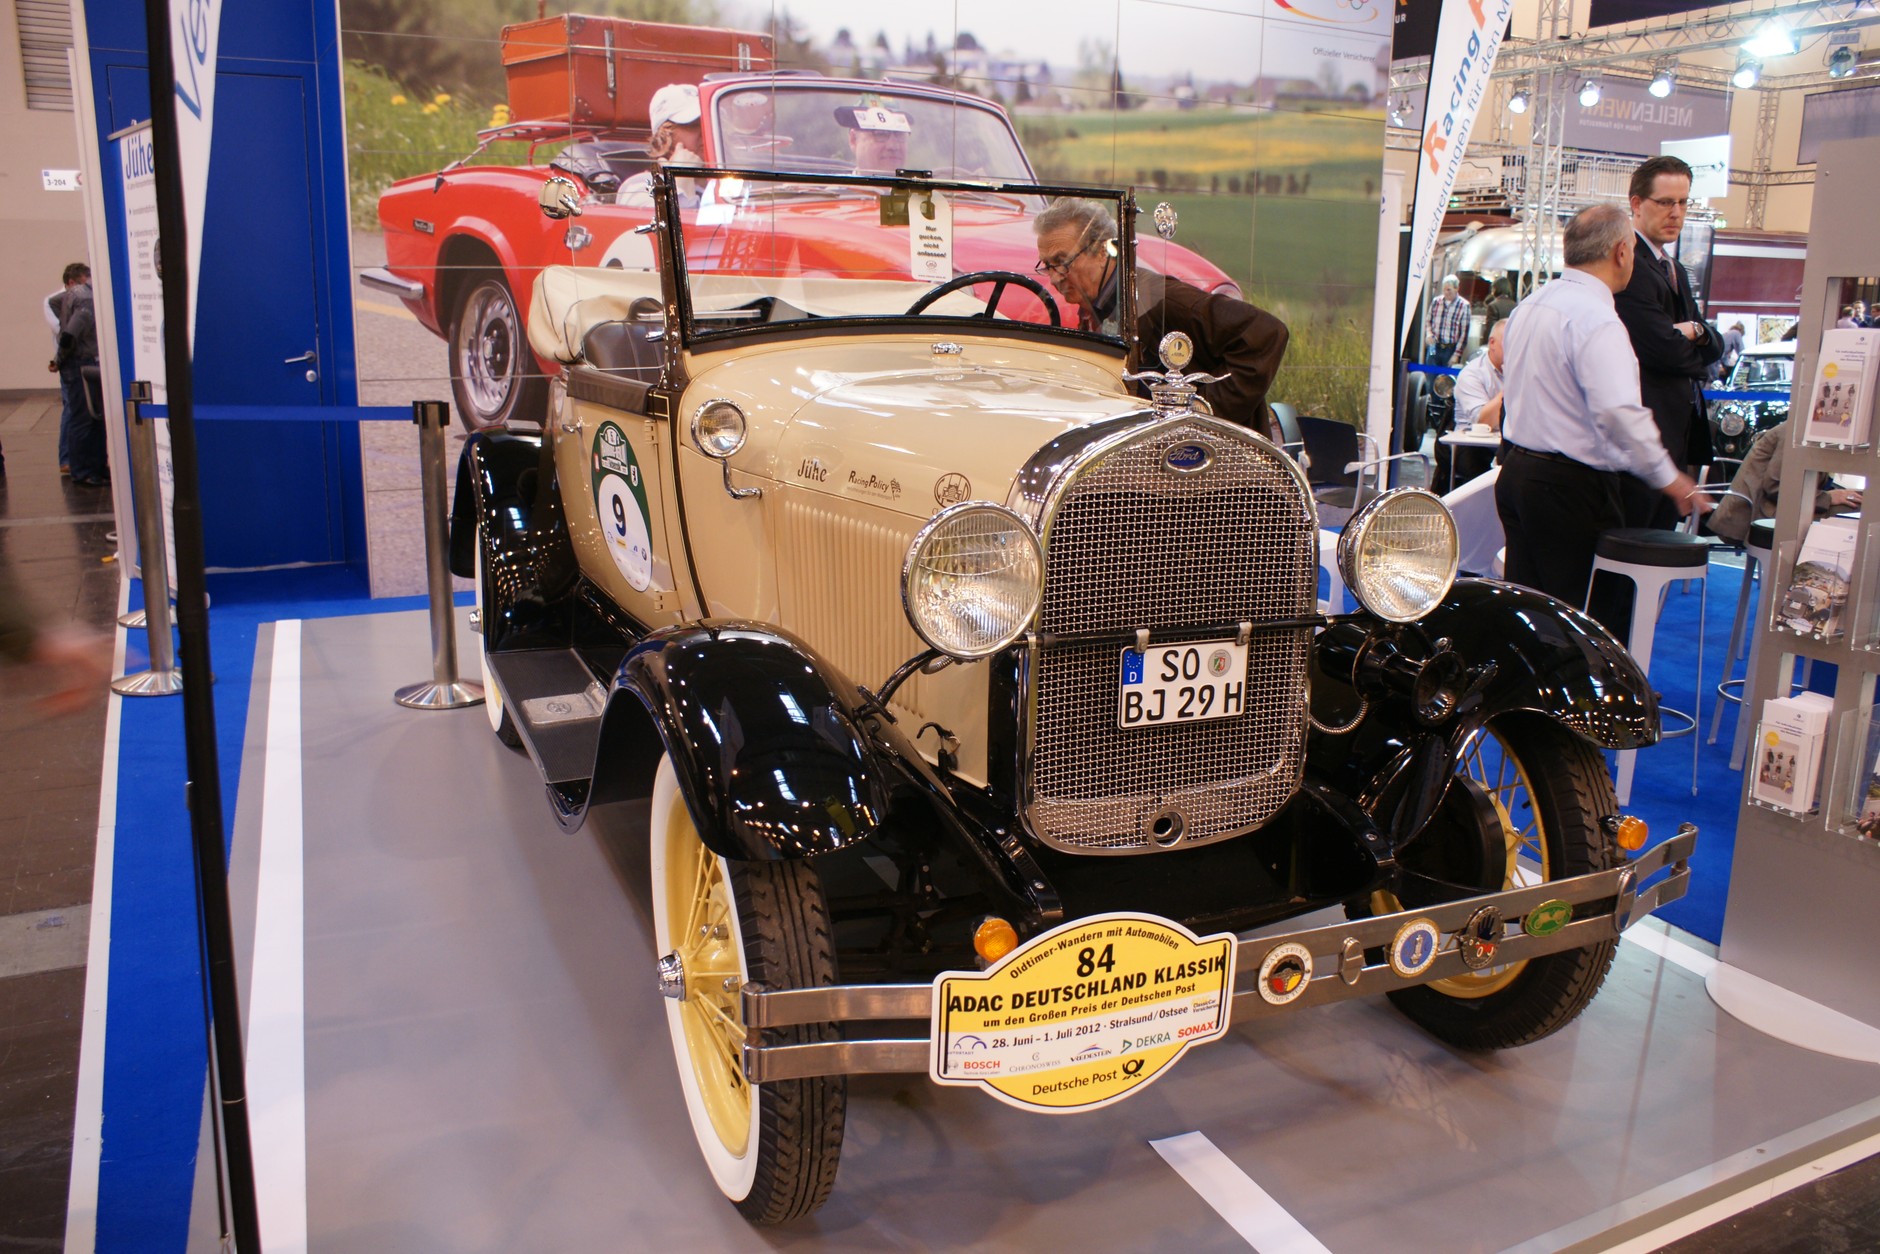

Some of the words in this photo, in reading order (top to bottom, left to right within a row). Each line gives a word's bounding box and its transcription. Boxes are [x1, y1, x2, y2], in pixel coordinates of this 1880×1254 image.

[1412, 118, 1471, 280] Versicherungen
[1467, 78, 1482, 111] für
[1481, 30, 1500, 75] den
[1169, 448, 1200, 461] Ford
[797, 458, 827, 483] Jühe
[612, 493, 626, 537] 9
[1129, 671, 1137, 682] D
[1160, 648, 1200, 682] SO
[1124, 689, 1166, 723] BJ
[1177, 684, 1215, 718] 29
[1223, 681, 1243, 713] H
[1009, 931, 1103, 980] Oldtimer-Wandern
[1106, 926, 1123, 937] mit
[1125, 926, 1180, 950] Automobilen
[1076, 943, 1116, 978] 84
[949, 994, 1003, 1013] ADAC
[1011, 971, 1147, 1010] DEUTSCHLAND
[1153, 954, 1225, 985] KLASSIK
[983, 1019, 1000, 1027] um
[1005, 1016, 1025, 1026] den
[1029, 1009, 1067, 1025] Großen
[1071, 1002, 1097, 1016] Preis
[1101, 1000, 1118, 1010] der
[1121, 988, 1172, 1006] Deutschen
[1175, 983, 1196, 995] Post
[992, 1038, 1010, 1049] 28.
[1013, 1034, 1033, 1047] Juni
[1044, 1032, 1053, 1042] 1.
[1056, 1028, 1073, 1040] Juli
[1075, 1022, 1101, 1036] 2012
[1136, 1032, 1171, 1048] DEKRA
[1177, 1021, 1215, 1038] SONAX
[963, 1060, 1001, 1070] BOSCH
[1032, 1073, 1090, 1096] Deutsche
[1092, 1068, 1117, 1083] Post
